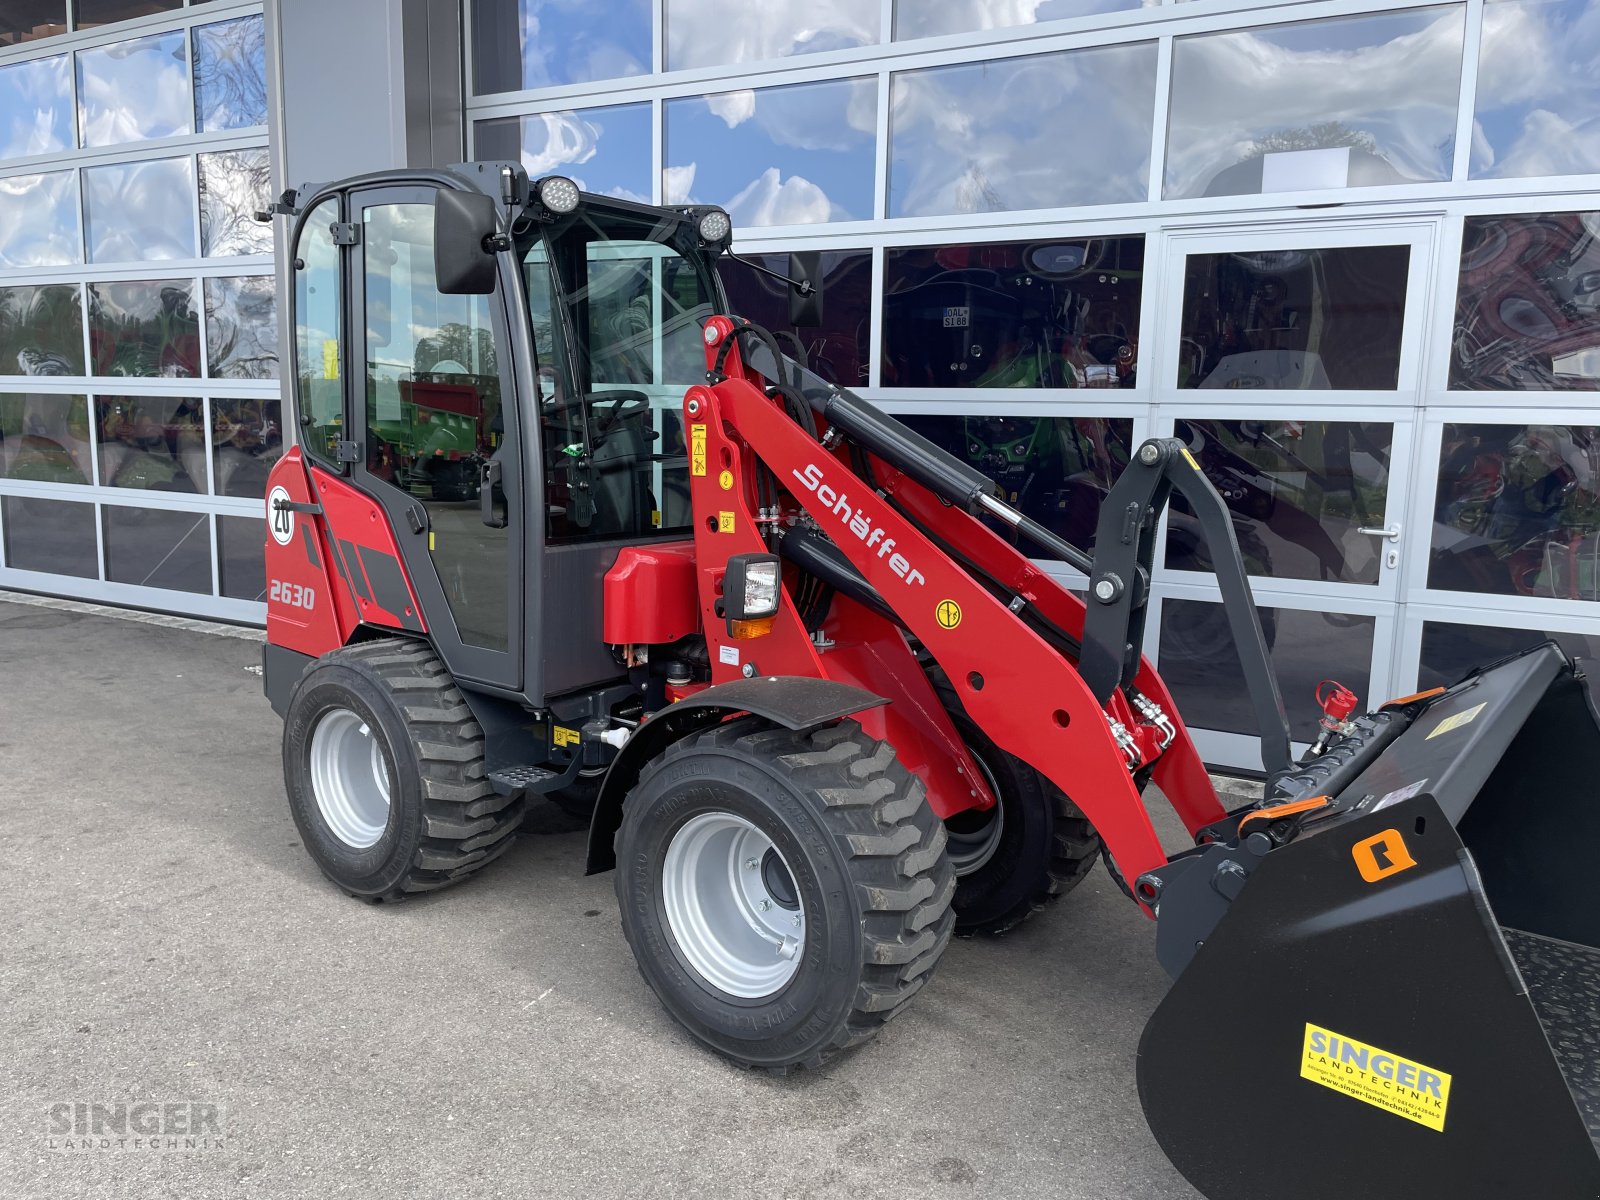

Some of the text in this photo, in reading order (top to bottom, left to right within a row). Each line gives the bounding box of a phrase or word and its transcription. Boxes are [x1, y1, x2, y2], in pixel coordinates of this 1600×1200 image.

[273, 498, 290, 534] 20
[792, 463, 925, 586] Schäffer
[270, 579, 315, 610] 2630
[1308, 1051, 1442, 1108] LANDTECHNIK
[1309, 1031, 1442, 1099] SINGER
[1319, 1075, 1422, 1119] www.singer-landtechnik.de
